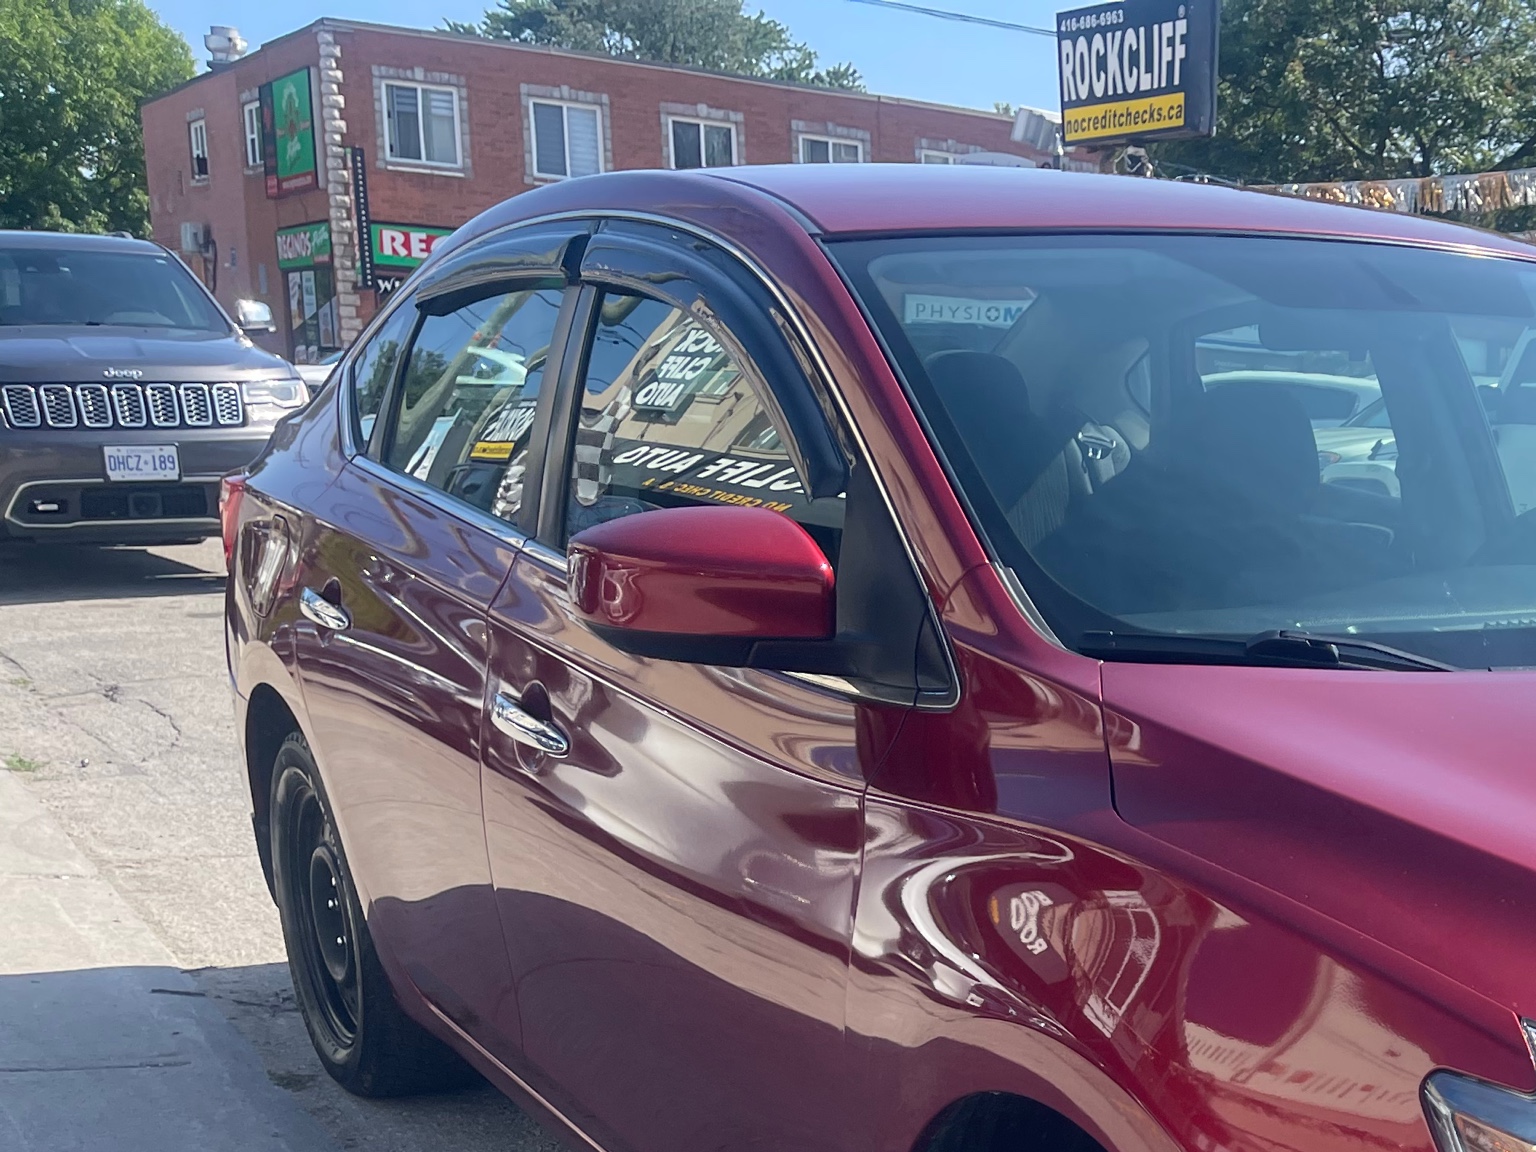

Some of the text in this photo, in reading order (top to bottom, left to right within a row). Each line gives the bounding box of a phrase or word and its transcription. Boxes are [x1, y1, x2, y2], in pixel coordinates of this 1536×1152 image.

[1060, 9, 1124, 32] 416-686-6963
[1060, 19, 1187, 102] ROCKCLIFF
[1066, 103, 1183, 135] nocreditchecks.ca
[103, 367, 143, 380] Jeep
